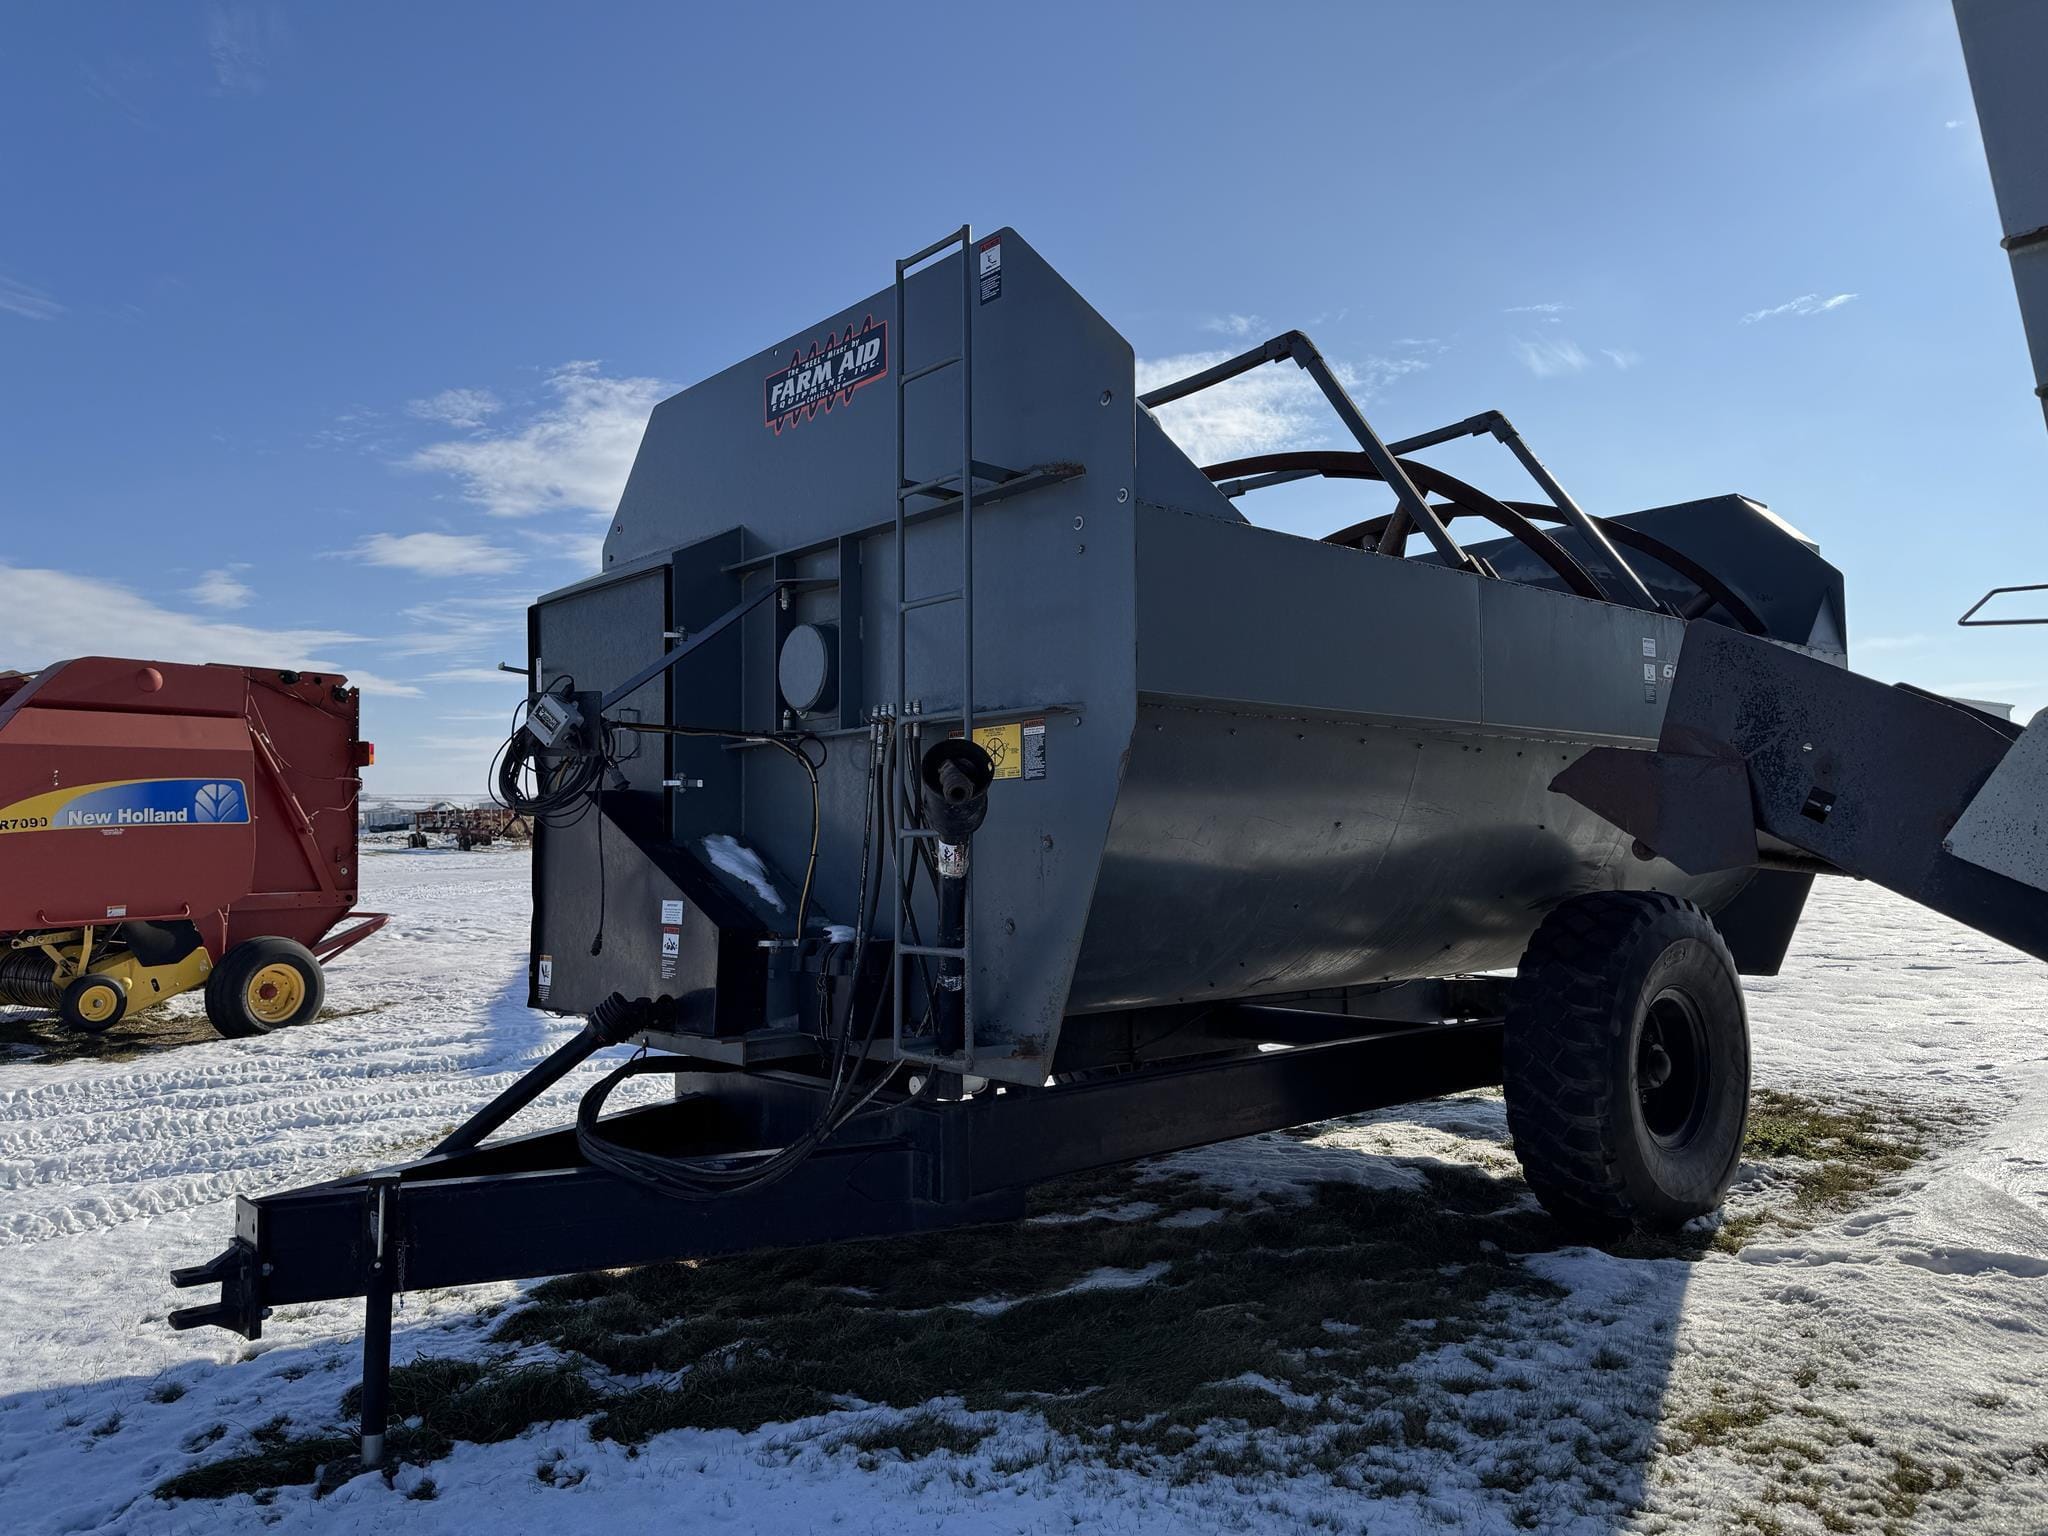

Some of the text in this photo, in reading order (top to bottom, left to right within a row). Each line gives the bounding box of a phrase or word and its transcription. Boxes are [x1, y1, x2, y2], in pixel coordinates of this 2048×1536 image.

[771, 338, 880, 405] FARM AID
[0, 816, 48, 830] R7090
[68, 807, 188, 826] New Holland
